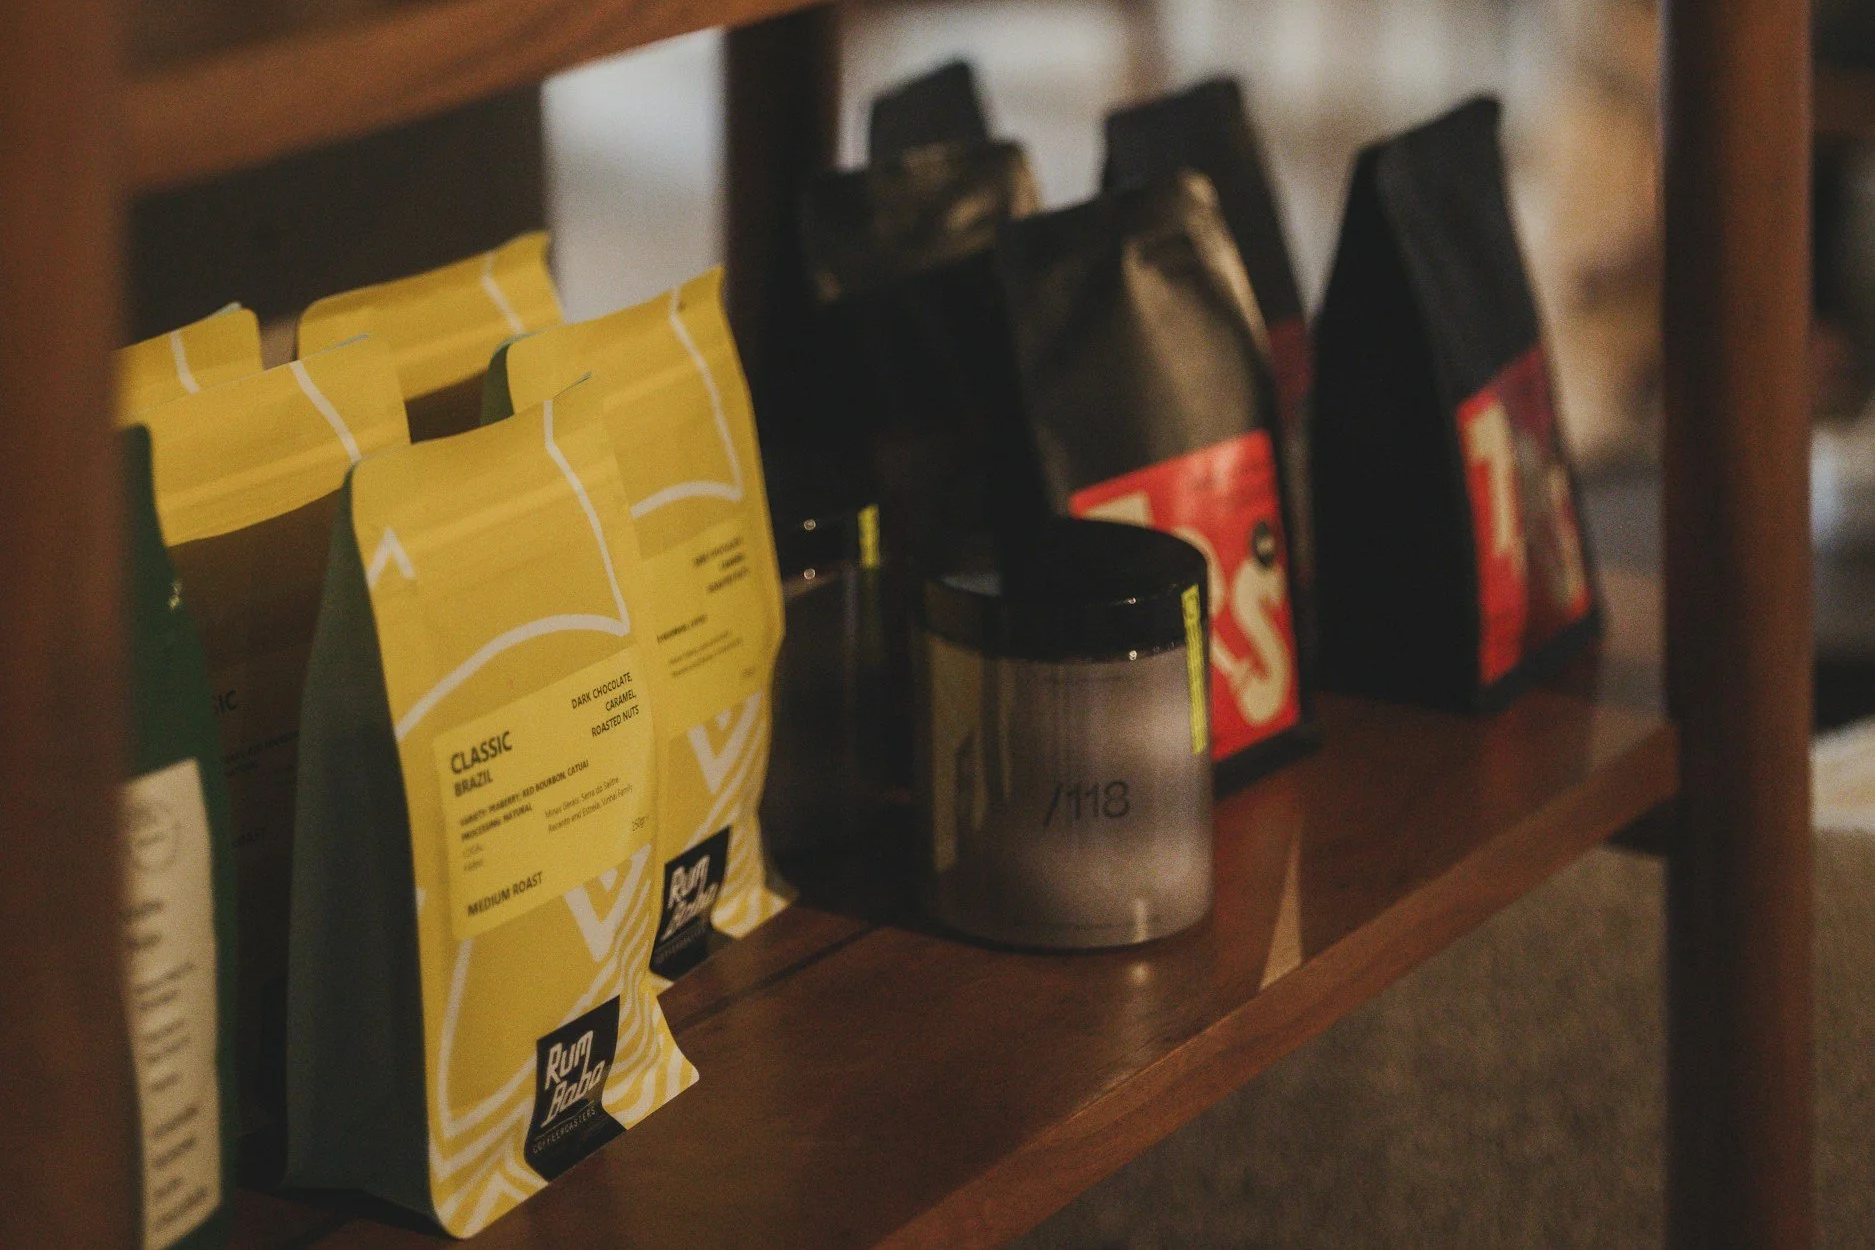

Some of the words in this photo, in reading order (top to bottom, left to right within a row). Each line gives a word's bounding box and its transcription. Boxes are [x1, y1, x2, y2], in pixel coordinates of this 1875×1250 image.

[571, 691, 592, 709] DARK
[593, 672, 633, 699] CHOCOLATE,
[605, 689, 637, 712] CARAMEL,
[591, 713, 621, 737] ROASTED
[622, 705, 639, 723] NUTS
[451, 730, 513, 775] CLASSIC
[454, 769, 493, 798] BRAZIL
[522, 786, 534, 799] RED
[567, 759, 589, 777] CATUAI
[581, 790, 596, 803] Serra
[502, 803, 533, 822] NATURAL
[571, 811, 582, 824] and
[617, 783, 633, 800] Family
[467, 886, 511, 917] MEDIUM
[512, 870, 543, 896] ROAST
[545, 1029, 594, 1090] Rum
[540, 1059, 606, 1128] Baba
